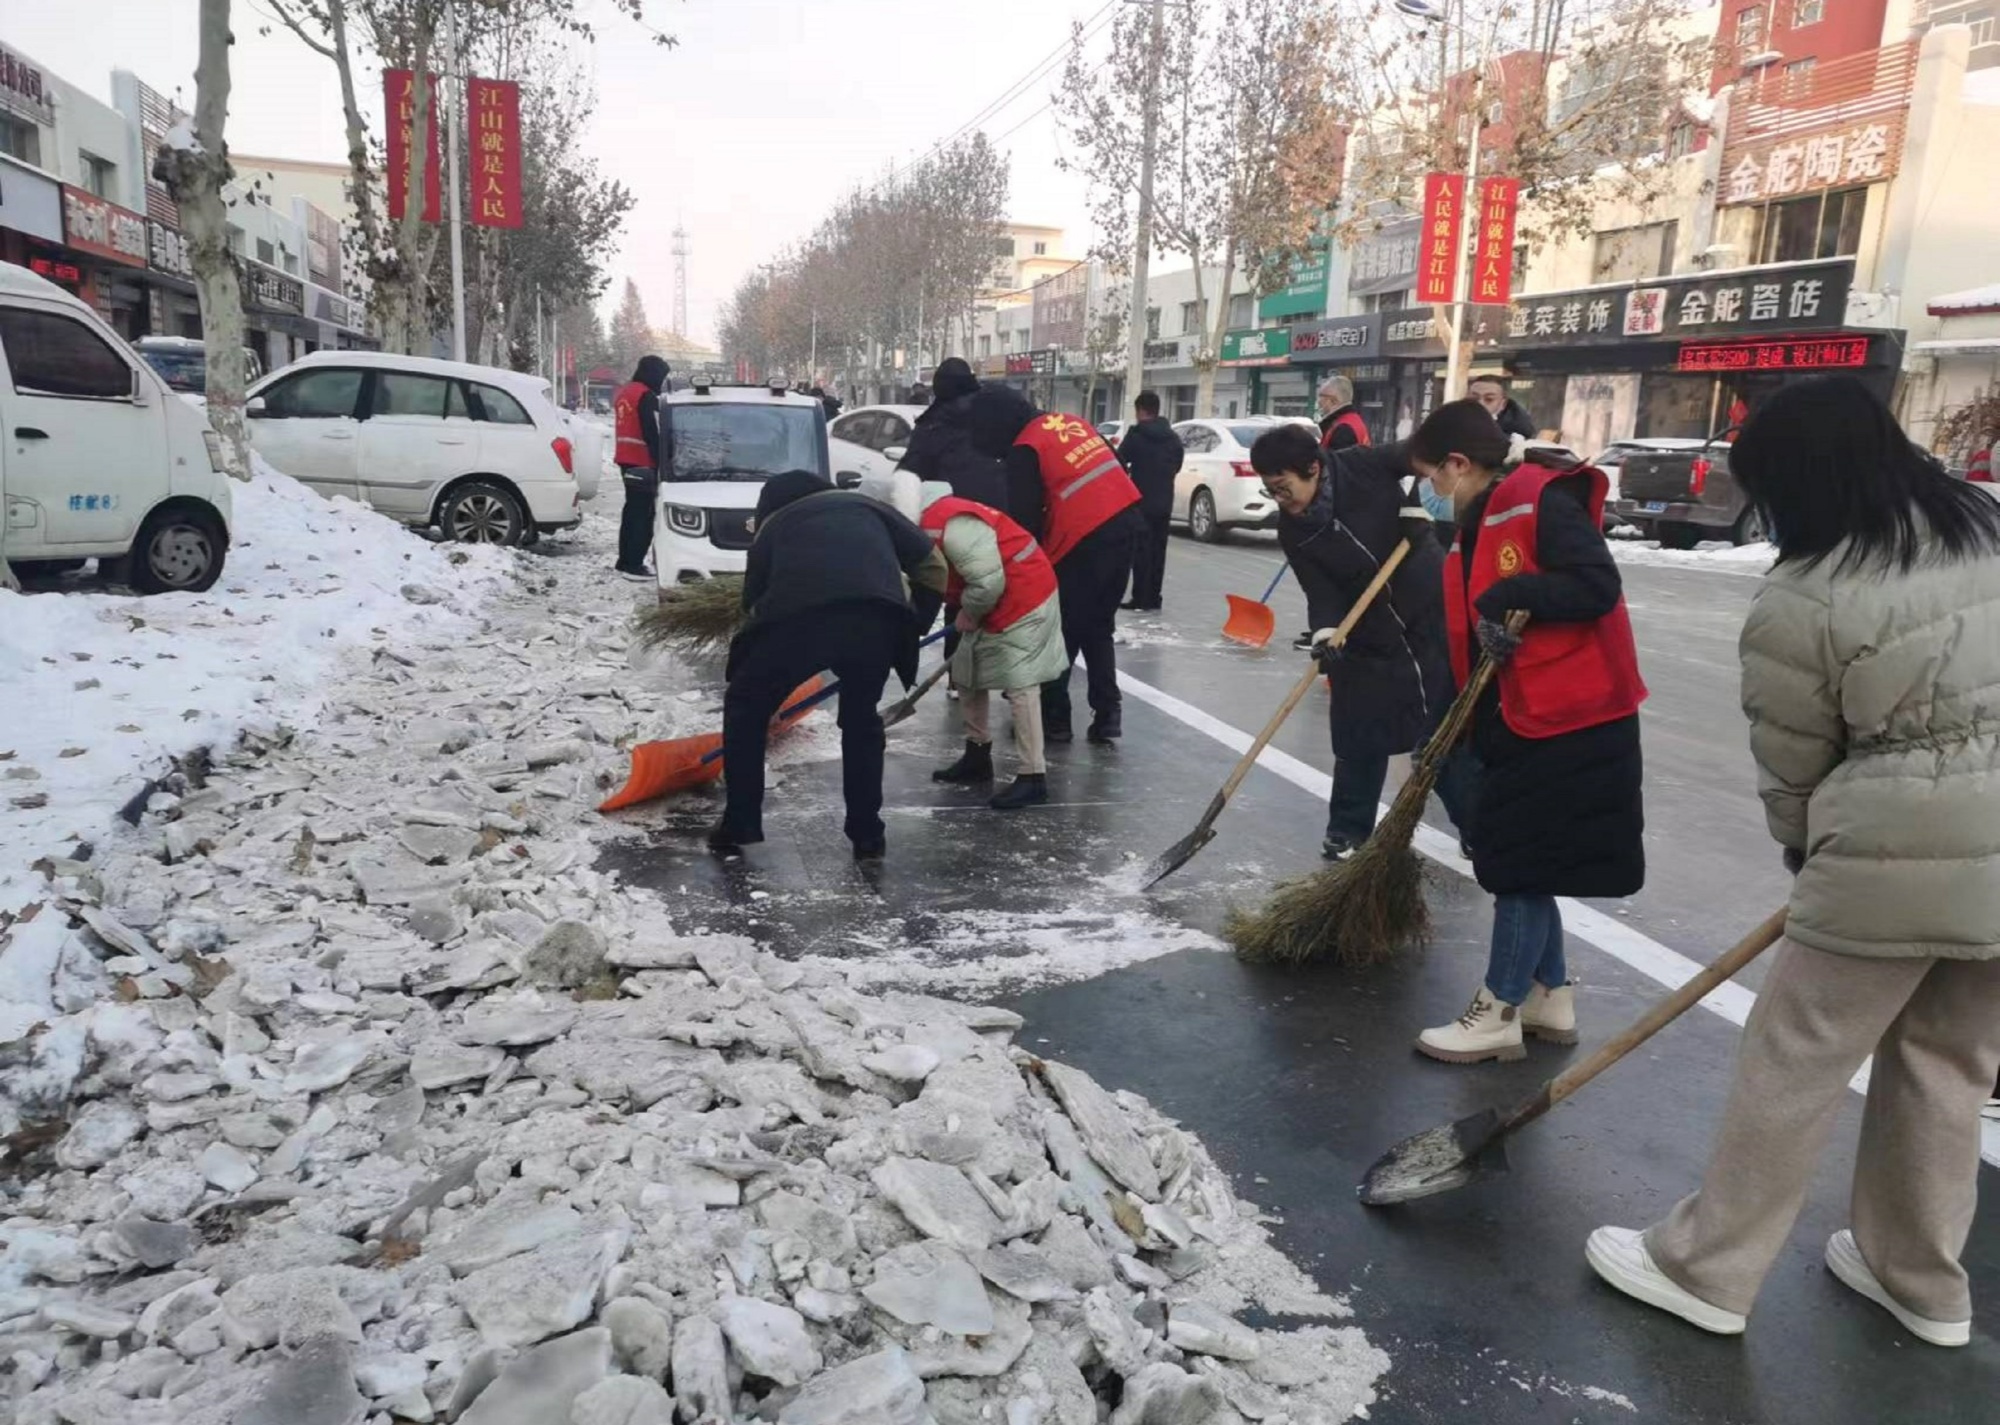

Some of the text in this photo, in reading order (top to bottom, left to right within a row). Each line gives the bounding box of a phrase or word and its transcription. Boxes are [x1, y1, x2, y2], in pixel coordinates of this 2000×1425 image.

[480, 86, 505, 218] 江山就是人民
[1726, 124, 1888, 203] 金舵陶瓷
[1428, 181, 1453, 294] 人民就是江山
[1481, 184, 1507, 296] 江山就是人民
[1510, 299, 1612, 338] 盛荣装饰
[1679, 280, 1822, 326] 金舵瓷砖
